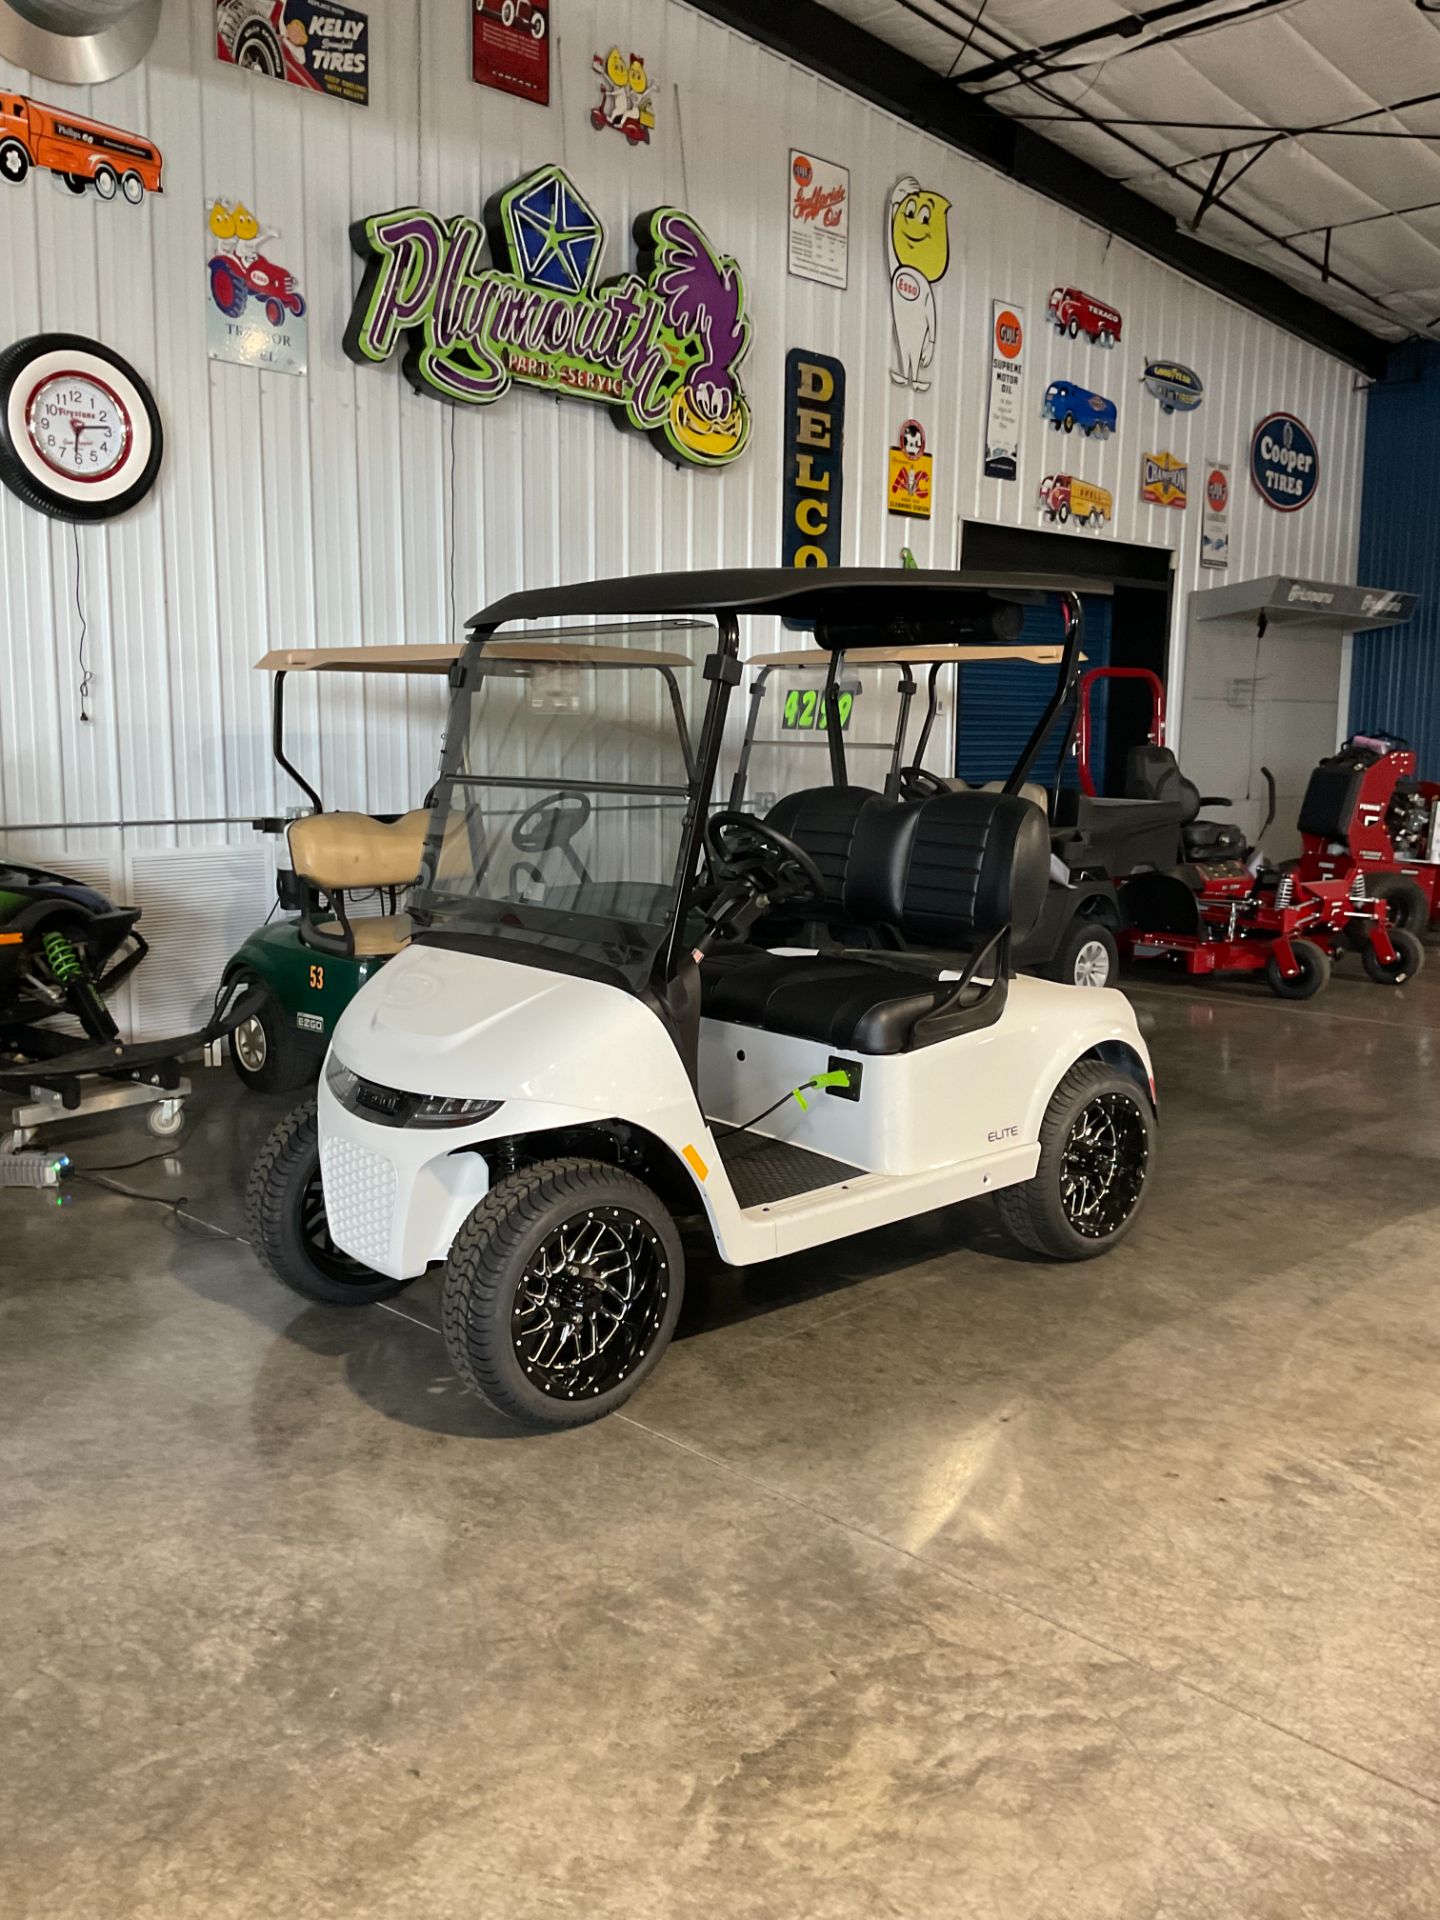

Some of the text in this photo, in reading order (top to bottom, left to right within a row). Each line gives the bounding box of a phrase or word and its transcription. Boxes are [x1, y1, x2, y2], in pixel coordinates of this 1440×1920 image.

[308, 15, 364, 40] KELLY
[312, 50, 366, 73] TIRES
[363, 212, 673, 425] Plymouth
[1088, 304, 1119, 323] TEXACO
[1000, 322, 1019, 344] GULF
[993, 359, 1022, 374] SUPREME
[997, 372, 1019, 385] MOTOR
[1001, 384, 1013, 394] OIL
[56, 393, 67, 405] 11
[68, 390, 82, 403] 12
[46, 404, 57, 416] 10
[90, 398, 95, 409] 1
[99, 410, 107, 422] 2
[41, 418, 50, 430] 9
[48, 435, 56, 447] 8
[100, 441, 107, 452] 4
[59, 446, 66, 458] 7
[90, 450, 97, 462] 5
[1260, 435, 1313, 473] Cooper
[75, 453, 83, 465] 6
[793, 362, 834, 568] DELCO
[1146, 461, 1185, 492] CHAMPION
[1265, 469, 1303, 496] TIRES
[309, 965, 323, 989] 53
[987, 1125, 1019, 1142] ELITE
